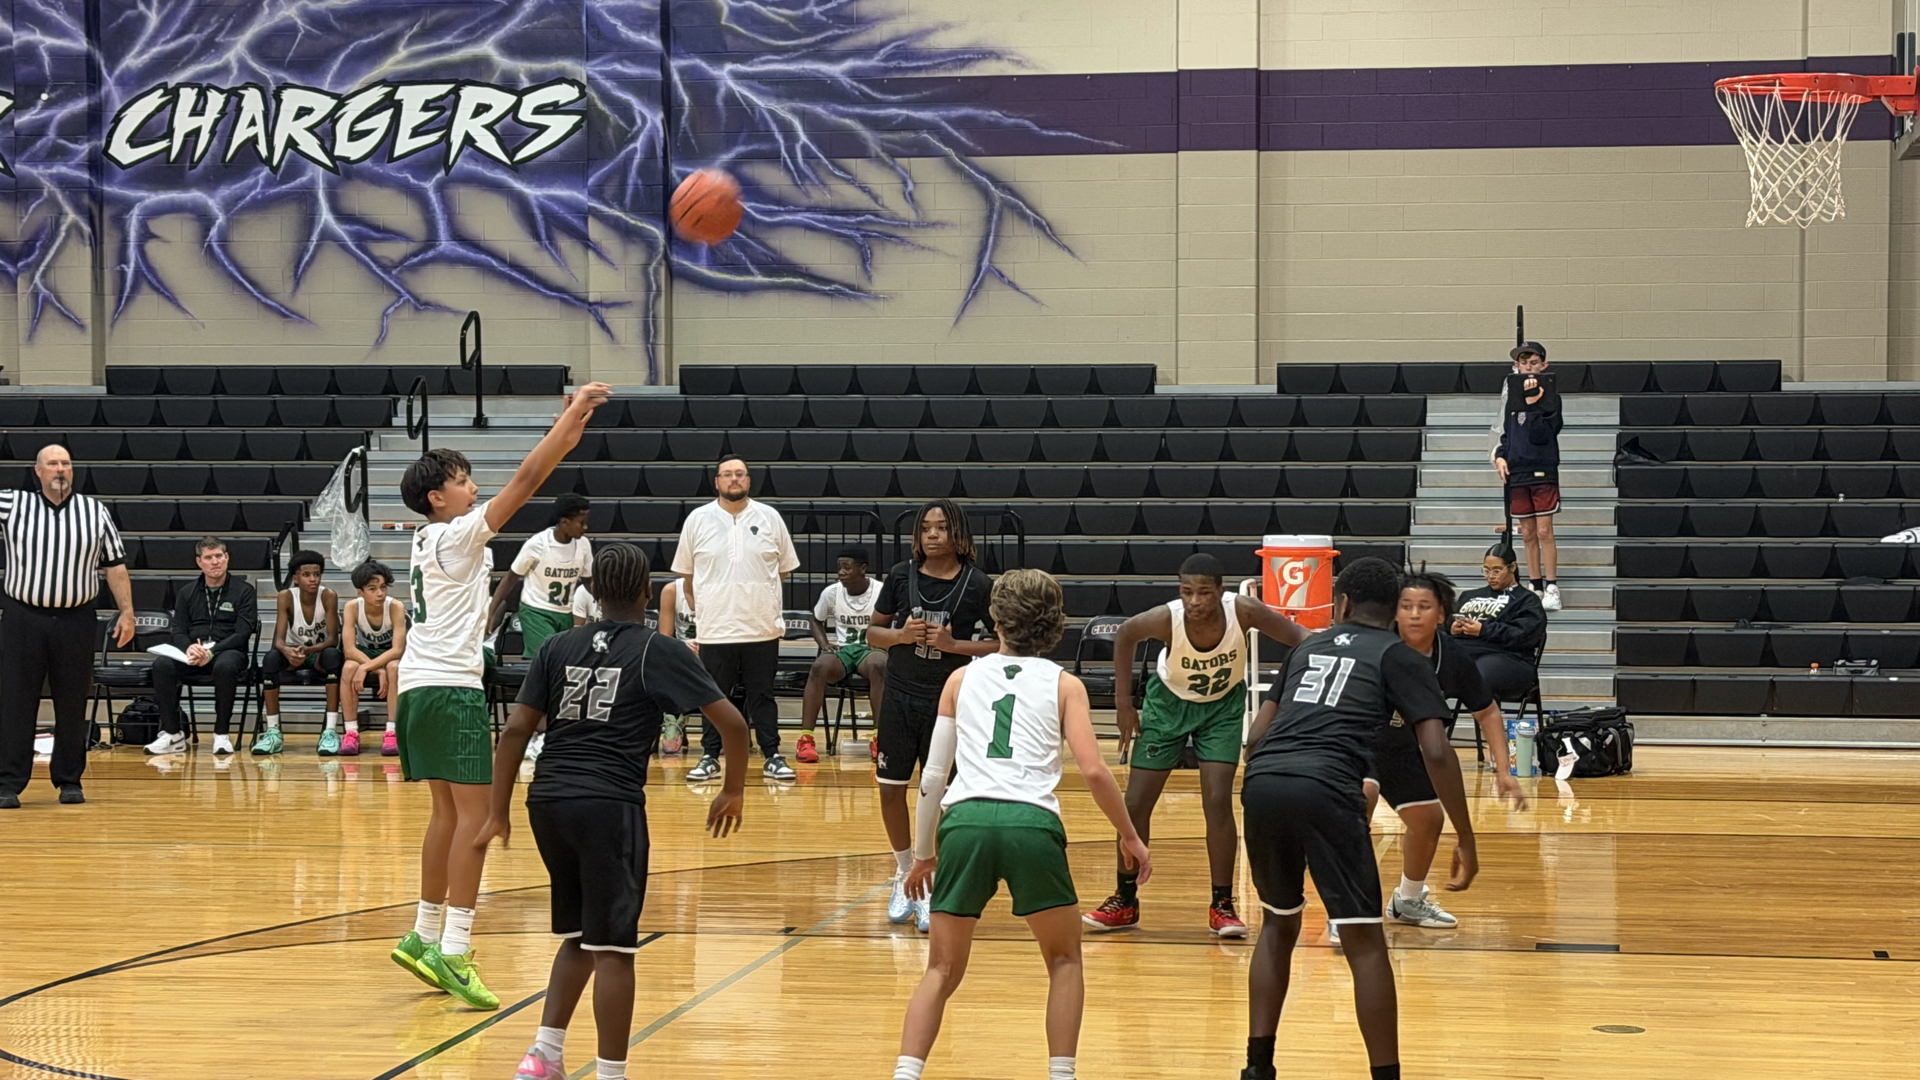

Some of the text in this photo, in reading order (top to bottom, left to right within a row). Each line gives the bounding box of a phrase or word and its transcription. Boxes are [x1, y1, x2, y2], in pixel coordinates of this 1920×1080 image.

[105, 79, 588, 174] CHARGERS
[544, 567, 579, 578] GATORS
[1282, 561, 1303, 585] G
[549, 581, 570, 606] 21
[840, 615, 870, 625] GATOR
[1459, 600, 1505, 618] BRISCOE
[1181, 649, 1237, 671] GATORS
[1187, 668, 1232, 696] 22
[1293, 654, 1356, 707] 31
[556, 666, 622, 721] 22
[986, 693, 1016, 758] 1
